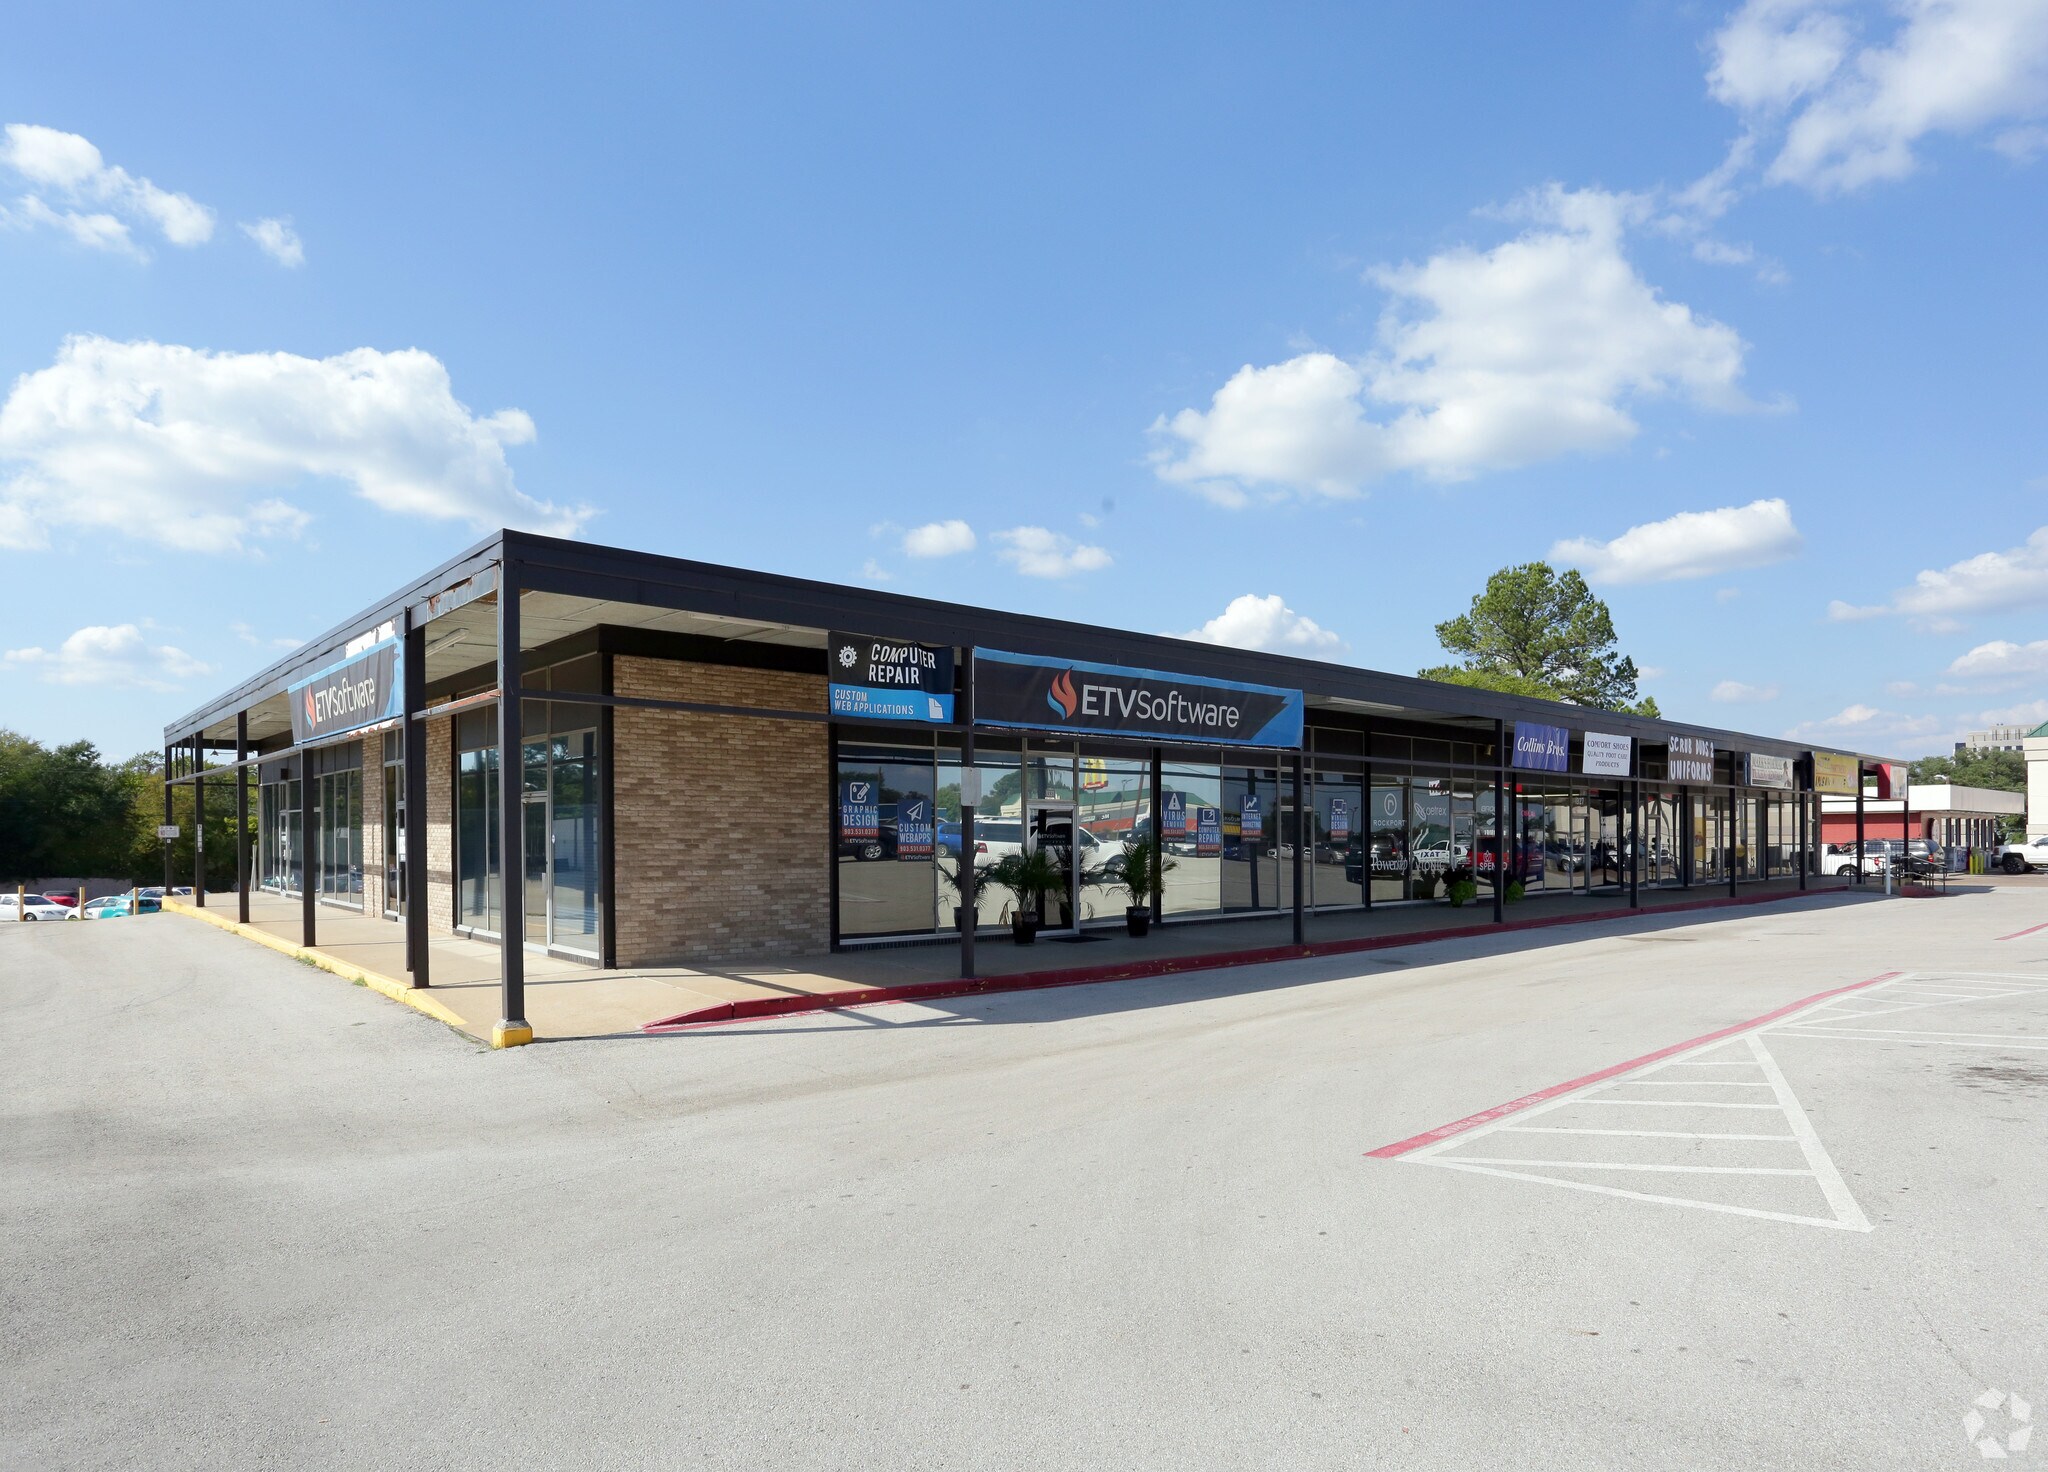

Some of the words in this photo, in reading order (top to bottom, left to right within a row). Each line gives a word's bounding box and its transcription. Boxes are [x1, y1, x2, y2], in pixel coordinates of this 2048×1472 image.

[871, 643, 936, 669] COMPUTER
[868, 663, 920, 684] REPAIR
[315, 677, 375, 723] ETVSoftware
[834, 688, 868, 702] CUSTOM
[834, 700, 852, 711] WEB
[853, 702, 914, 715] APPLICATIONS
[1081, 684, 1240, 728] ETVSoftware
[1517, 736, 1546, 754] Collins
[1546, 740, 1565, 757] Bros.
[1587, 740, 1611, 749] COMFORT
[1612, 742, 1629, 751] SHOES
[1669, 735, 1692, 754] SCRUB
[1595, 760, 1620, 769] PRODUCTS
[1670, 760, 1712, 782] UNIFORMS
[843, 805, 878, 814] GRAPHIC
[843, 814, 877, 826] DESIGN
[1163, 811, 1185, 821] VIRUS
[899, 823, 931, 833] CUSTOM
[1373, 819, 1405, 827] ROCKPORT
[899, 832, 931, 843] WEBAPPS
[1198, 833, 1220, 843] REPAIR
[1479, 862, 1508, 871] SPENO
